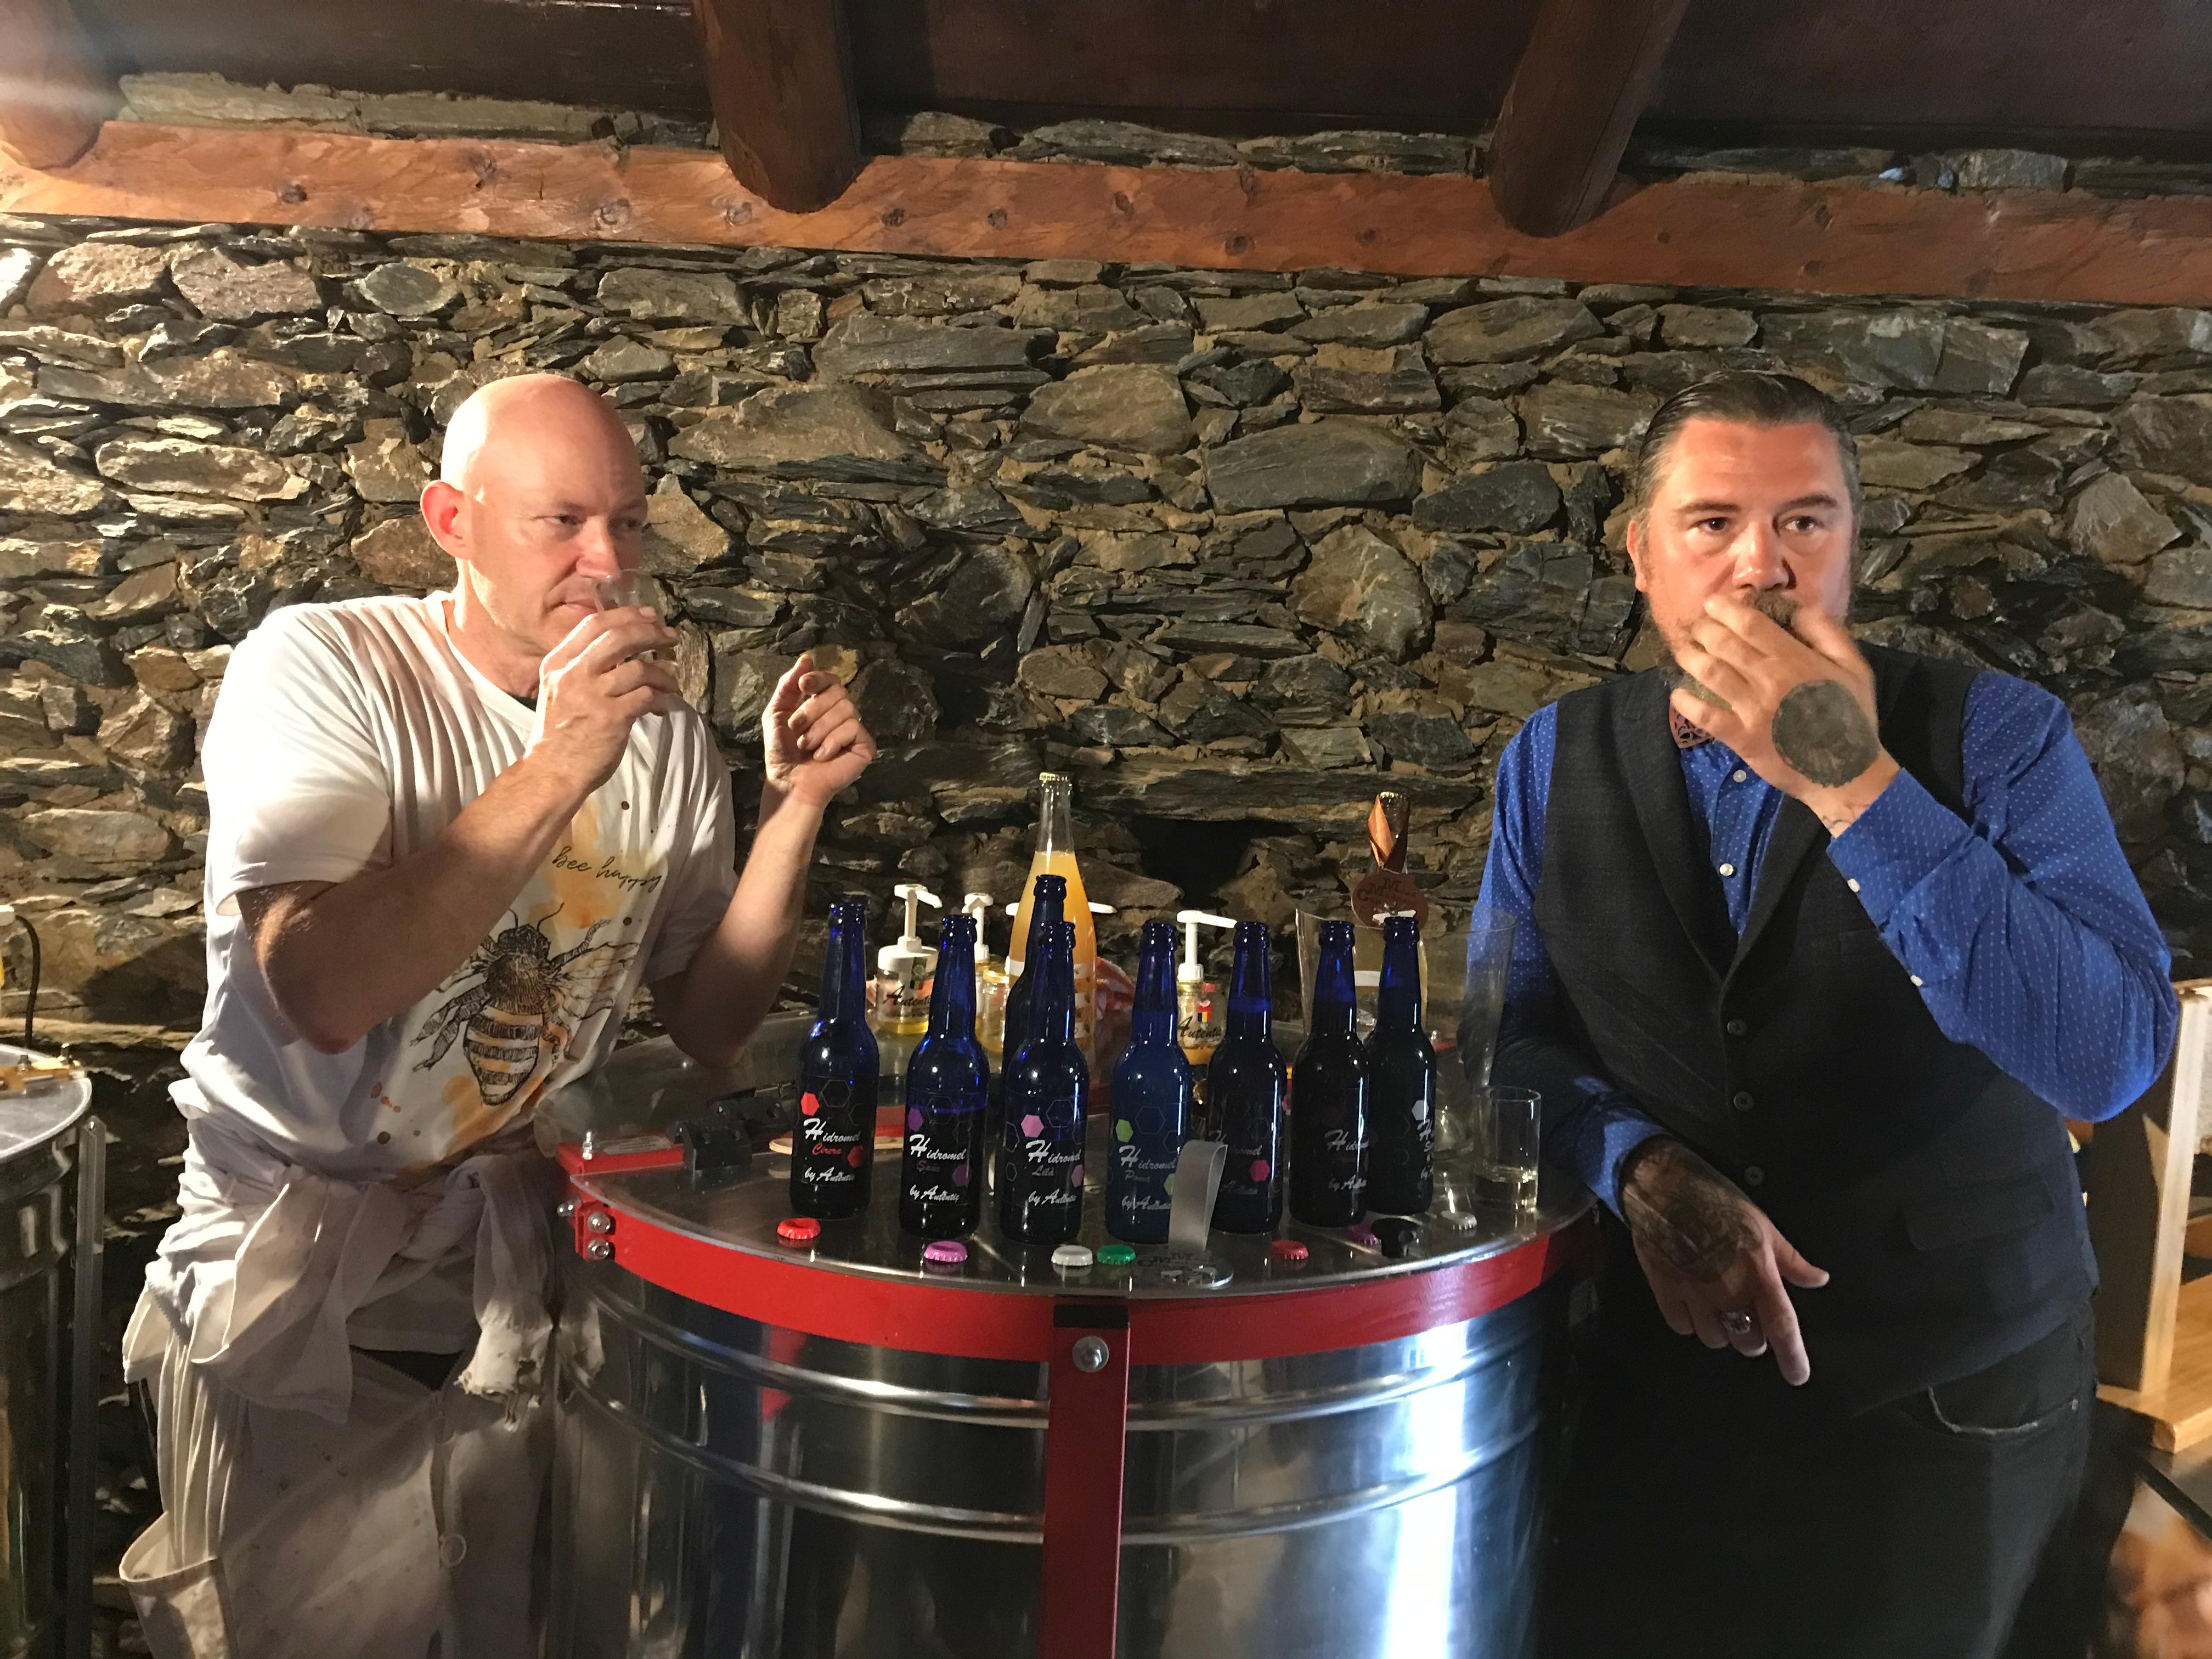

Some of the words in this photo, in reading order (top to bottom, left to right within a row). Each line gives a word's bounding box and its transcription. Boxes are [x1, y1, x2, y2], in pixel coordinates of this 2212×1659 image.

[552, 845, 592, 871] bee
[596, 855, 662, 893] happy
[803, 1118, 861, 1143] Hidromel
[909, 1133, 967, 1160] Hidromel
[1025, 1139, 1082, 1164] Hidromel
[1119, 1144, 1177, 1170] Hidromel
[804, 1166, 816, 1182] by
[909, 1184, 920, 1200] by
[1028, 1190, 1041, 1206] by
